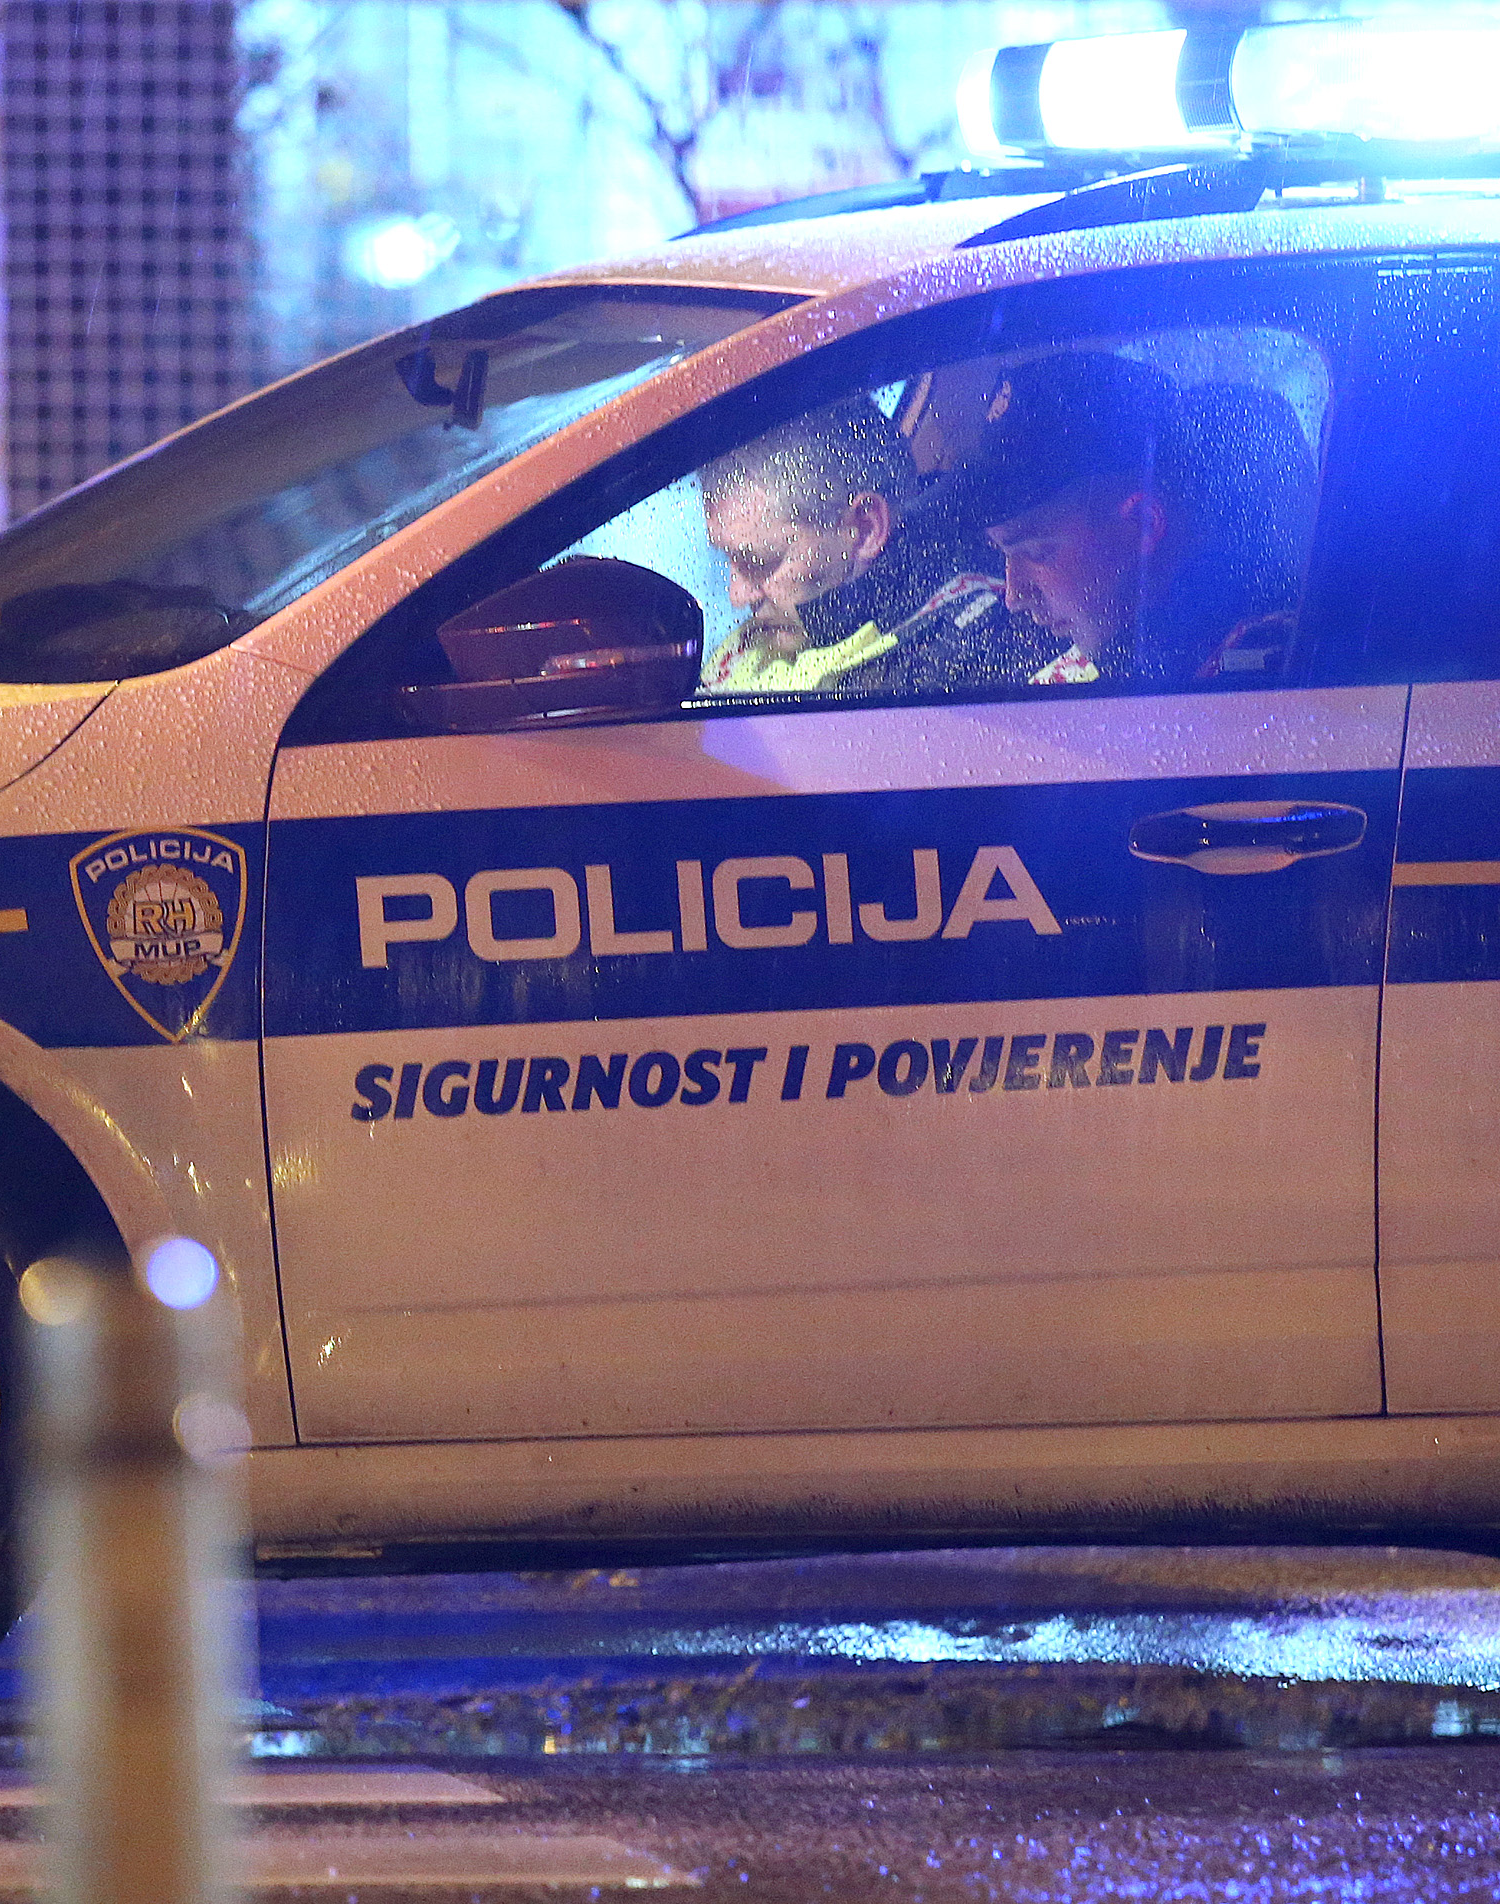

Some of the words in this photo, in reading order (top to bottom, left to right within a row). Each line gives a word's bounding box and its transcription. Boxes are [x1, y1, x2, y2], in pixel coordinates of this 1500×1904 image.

[85, 839, 234, 883] POLICIJA
[133, 898, 195, 935] RH
[355, 845, 1062, 968] POLICIJA
[134, 940, 200, 959] MUP
[351, 1047, 768, 1121] SIGURNOST
[781, 1045, 810, 1100] I
[826, 1022, 1267, 1099] POVJERENJE
